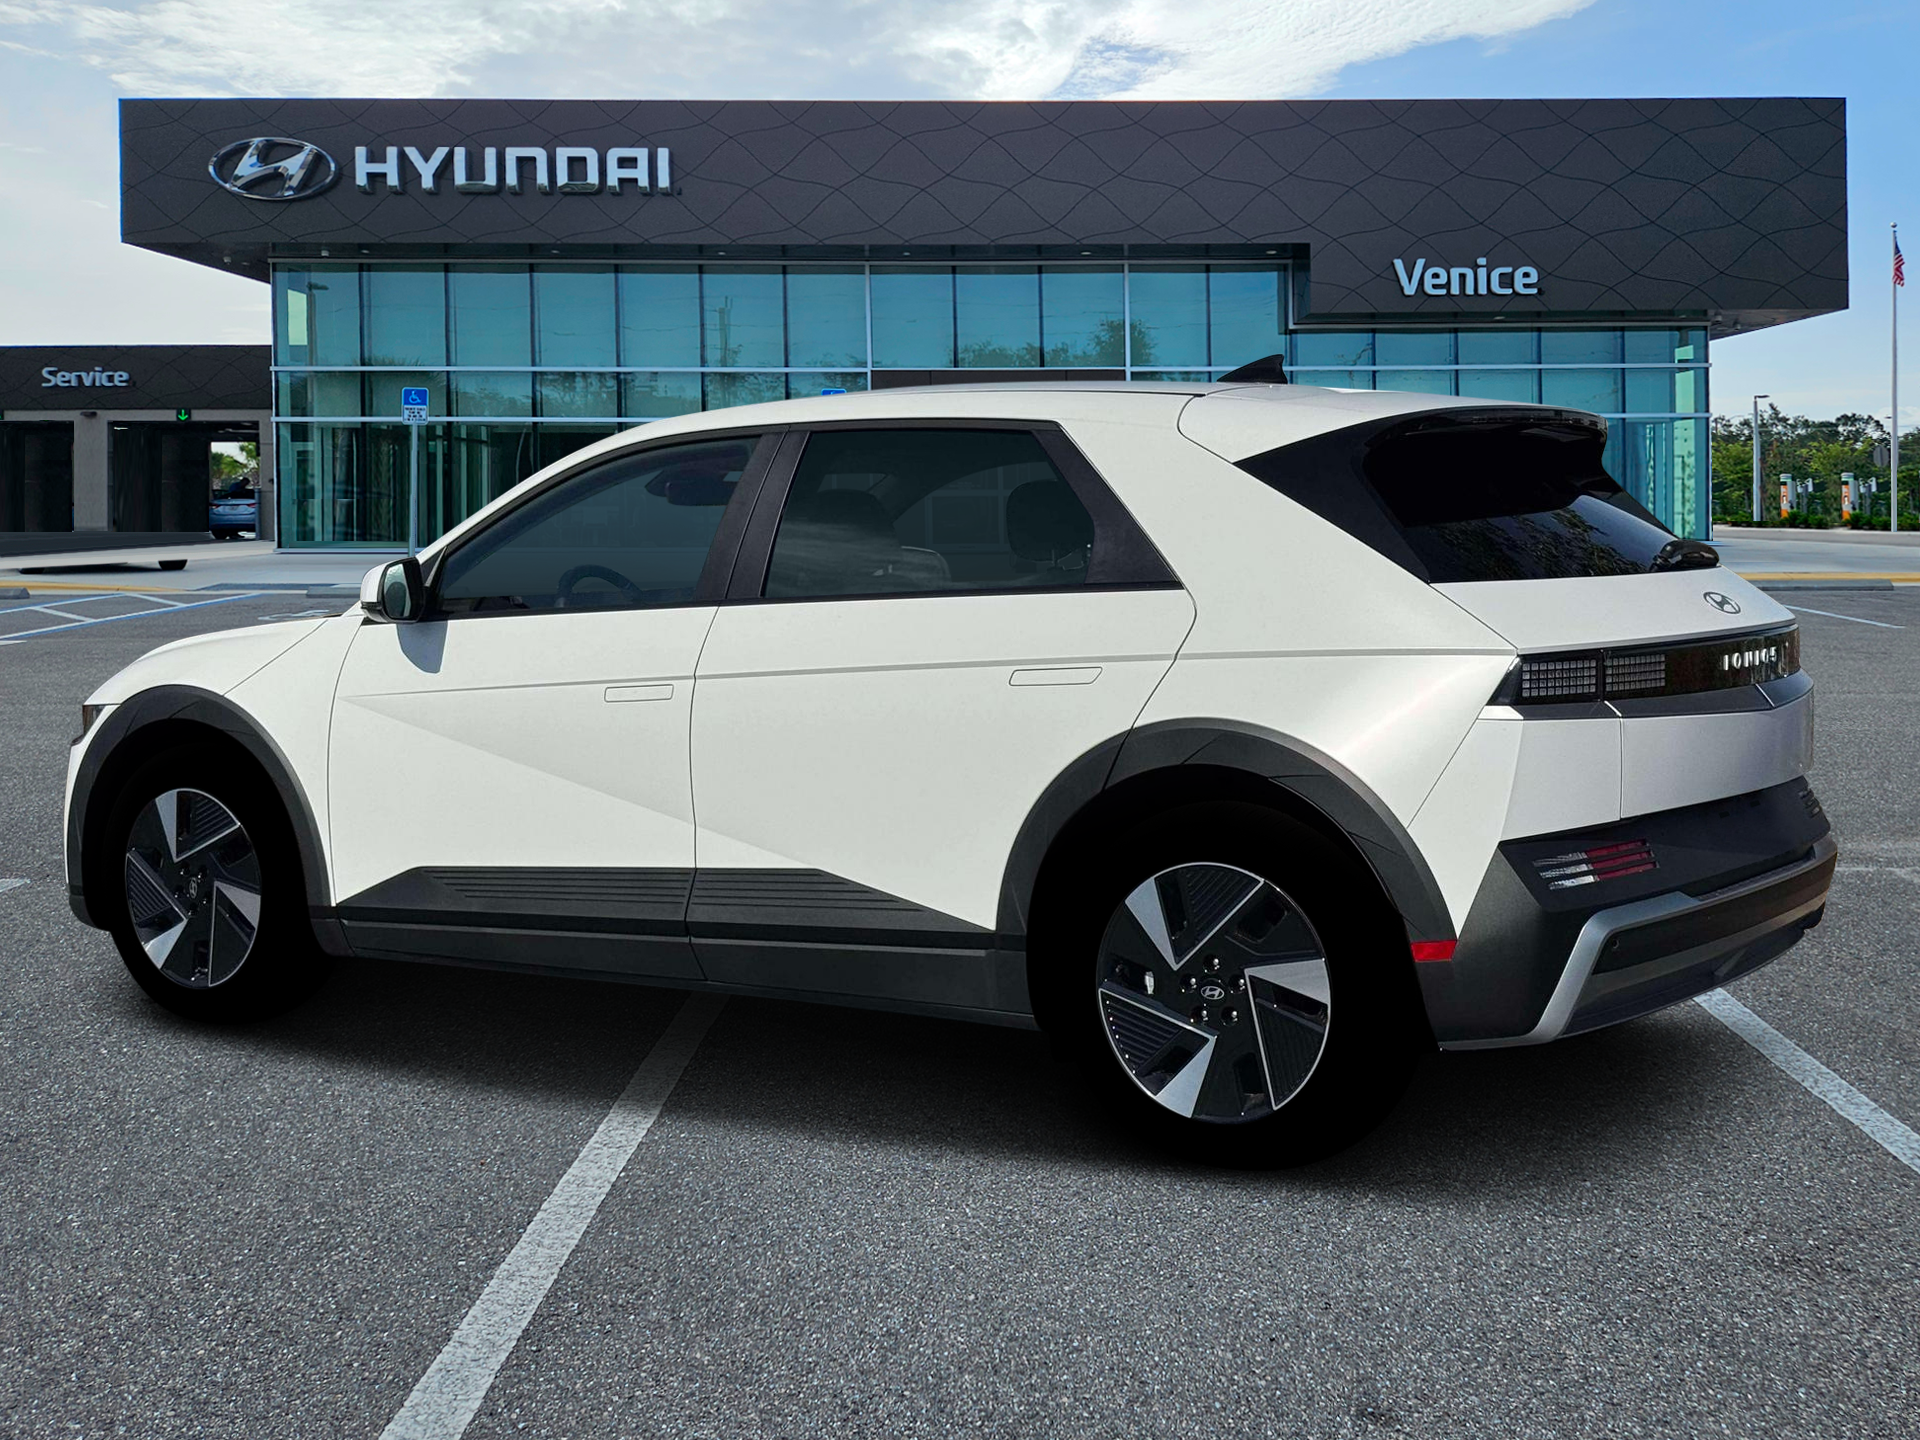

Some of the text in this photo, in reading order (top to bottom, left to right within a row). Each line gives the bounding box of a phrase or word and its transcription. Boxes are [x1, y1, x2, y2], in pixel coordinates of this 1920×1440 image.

[354, 146, 671, 194] HYUNDAI
[1393, 257, 1539, 295] Venice
[41, 367, 130, 387] Service
